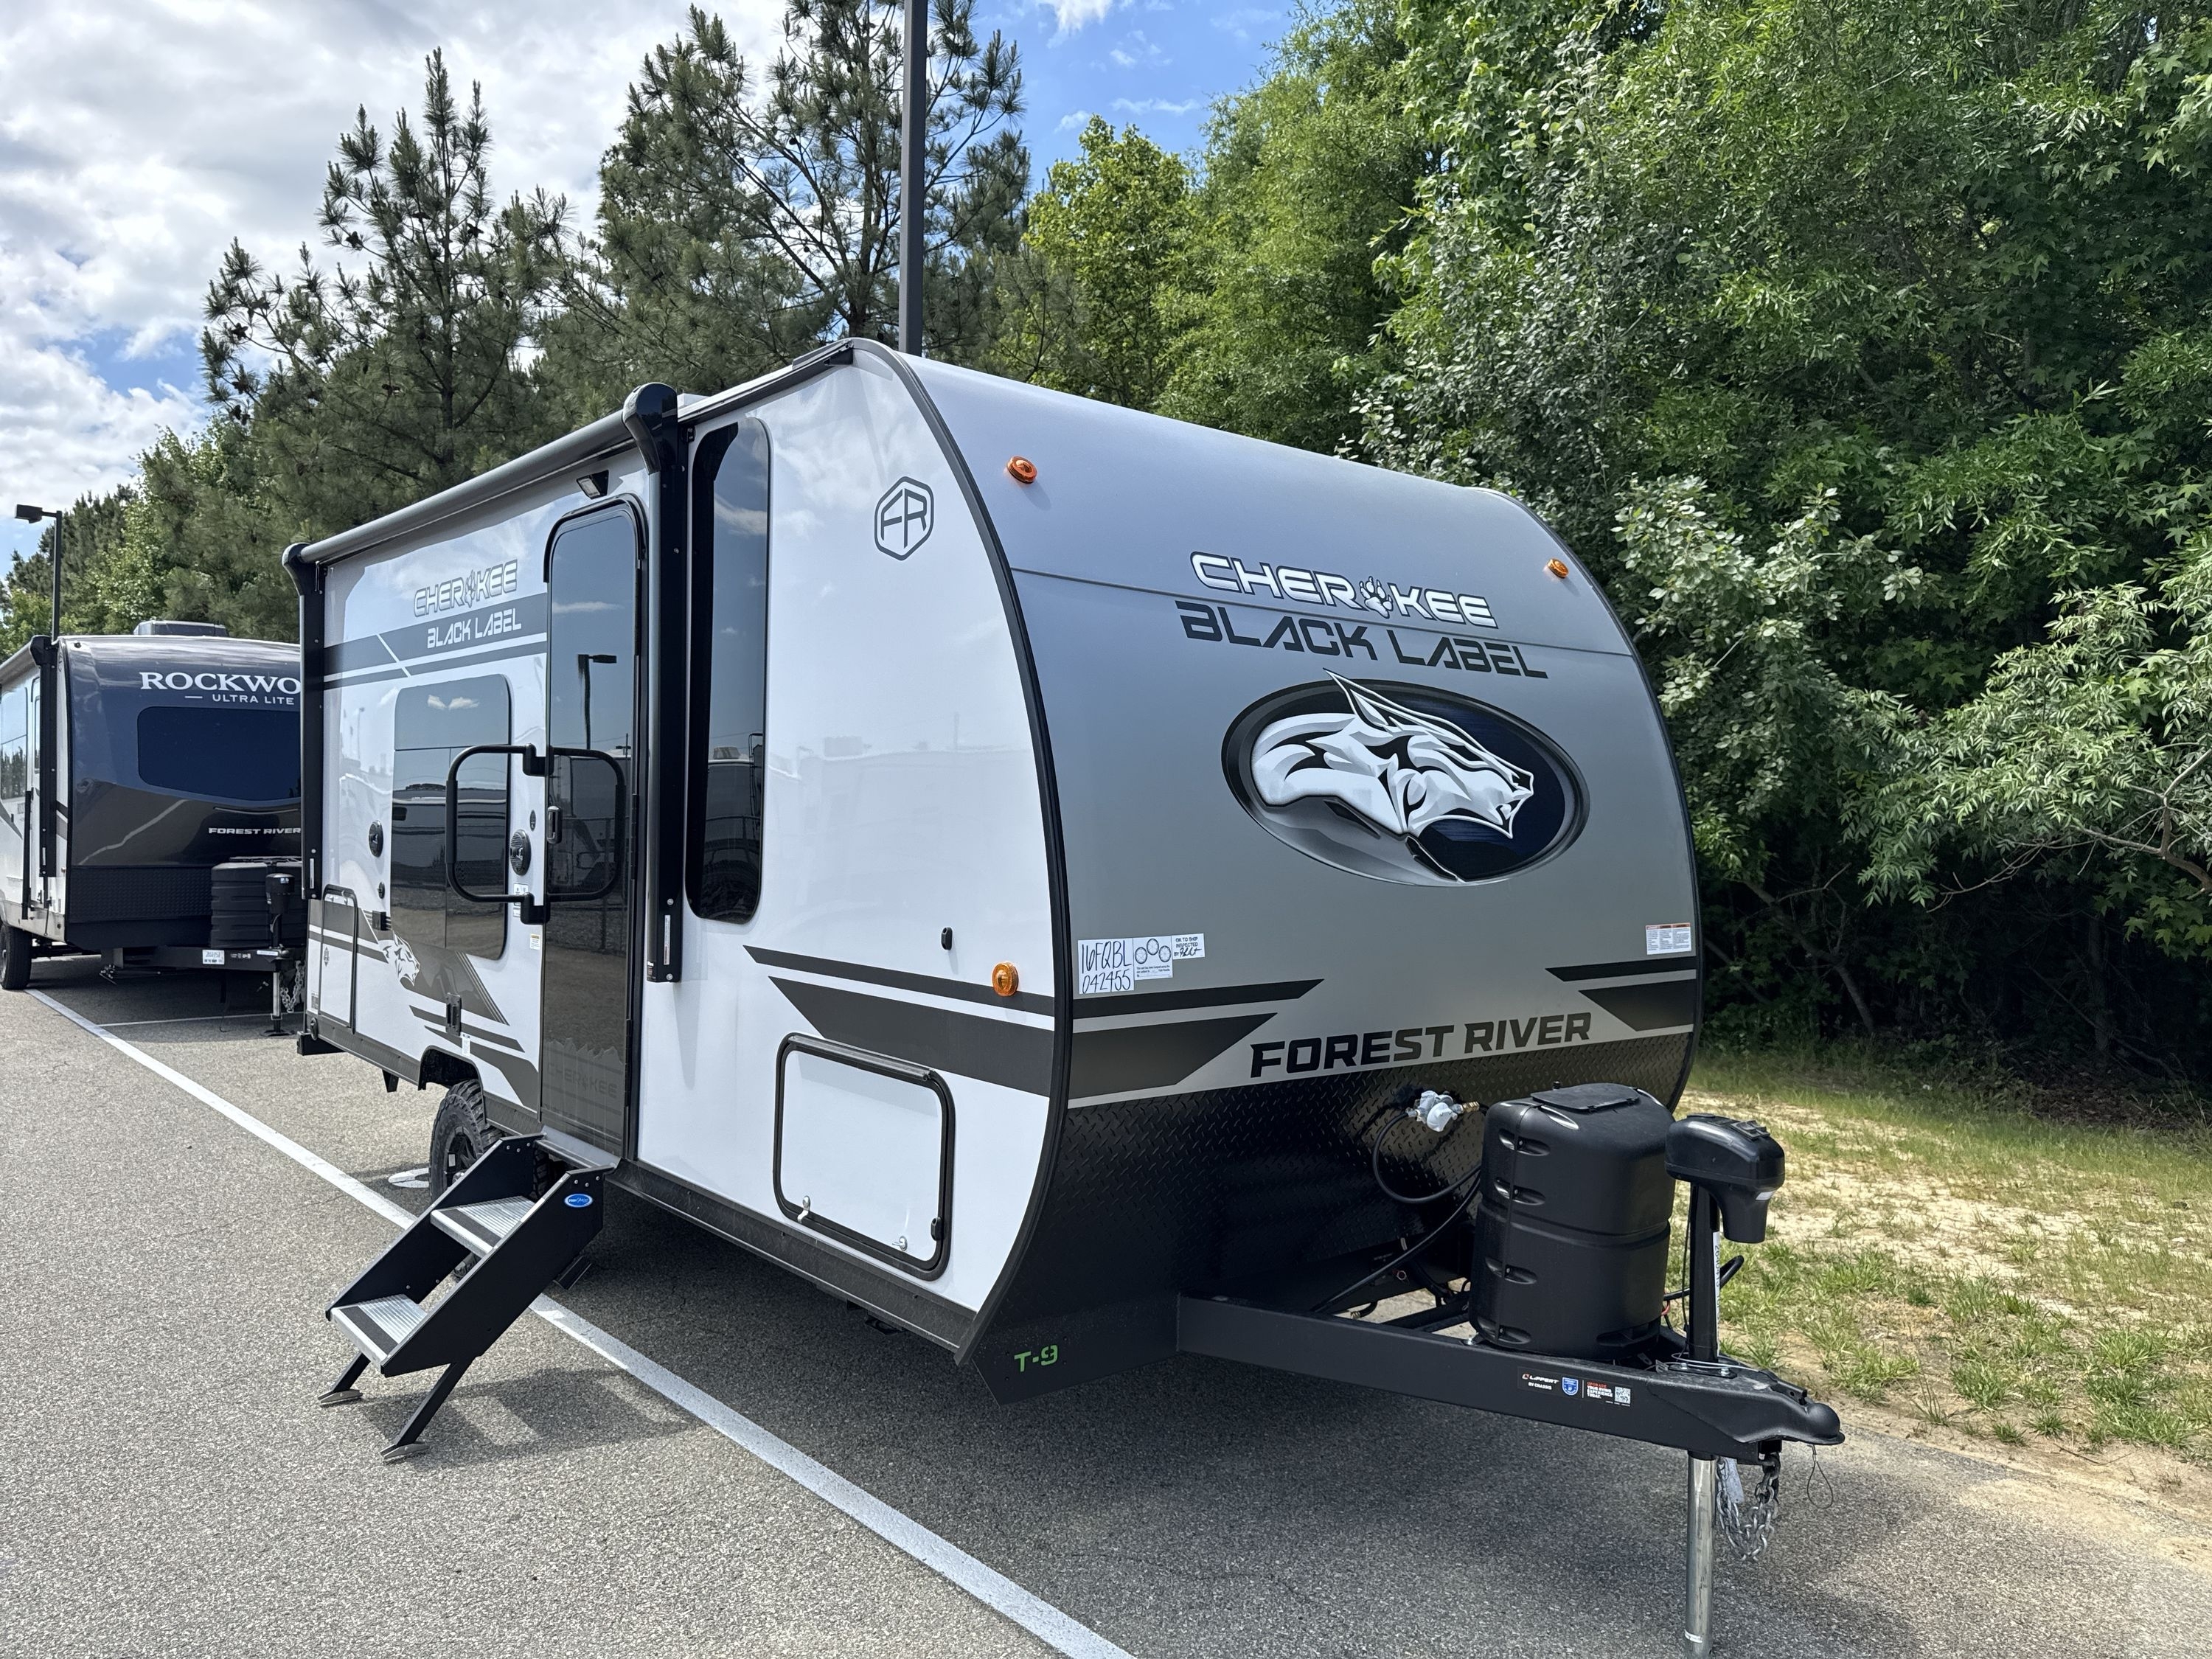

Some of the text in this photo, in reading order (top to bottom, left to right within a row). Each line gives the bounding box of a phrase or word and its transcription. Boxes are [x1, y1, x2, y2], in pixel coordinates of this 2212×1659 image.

[427, 608, 522, 649] BLACK LABEL
[1175, 600, 1548, 679] BLACK LABEL
[139, 671, 302, 695] ROCKWO
[212, 694, 295, 706] ULTRA LITE
[1082, 968, 1131, 994] 042455
[1250, 1012, 1591, 1079] FOREST RIVER
[1014, 1344, 1058, 1372] T-9
[1529, 1374, 1559, 1384] LIPPERT
